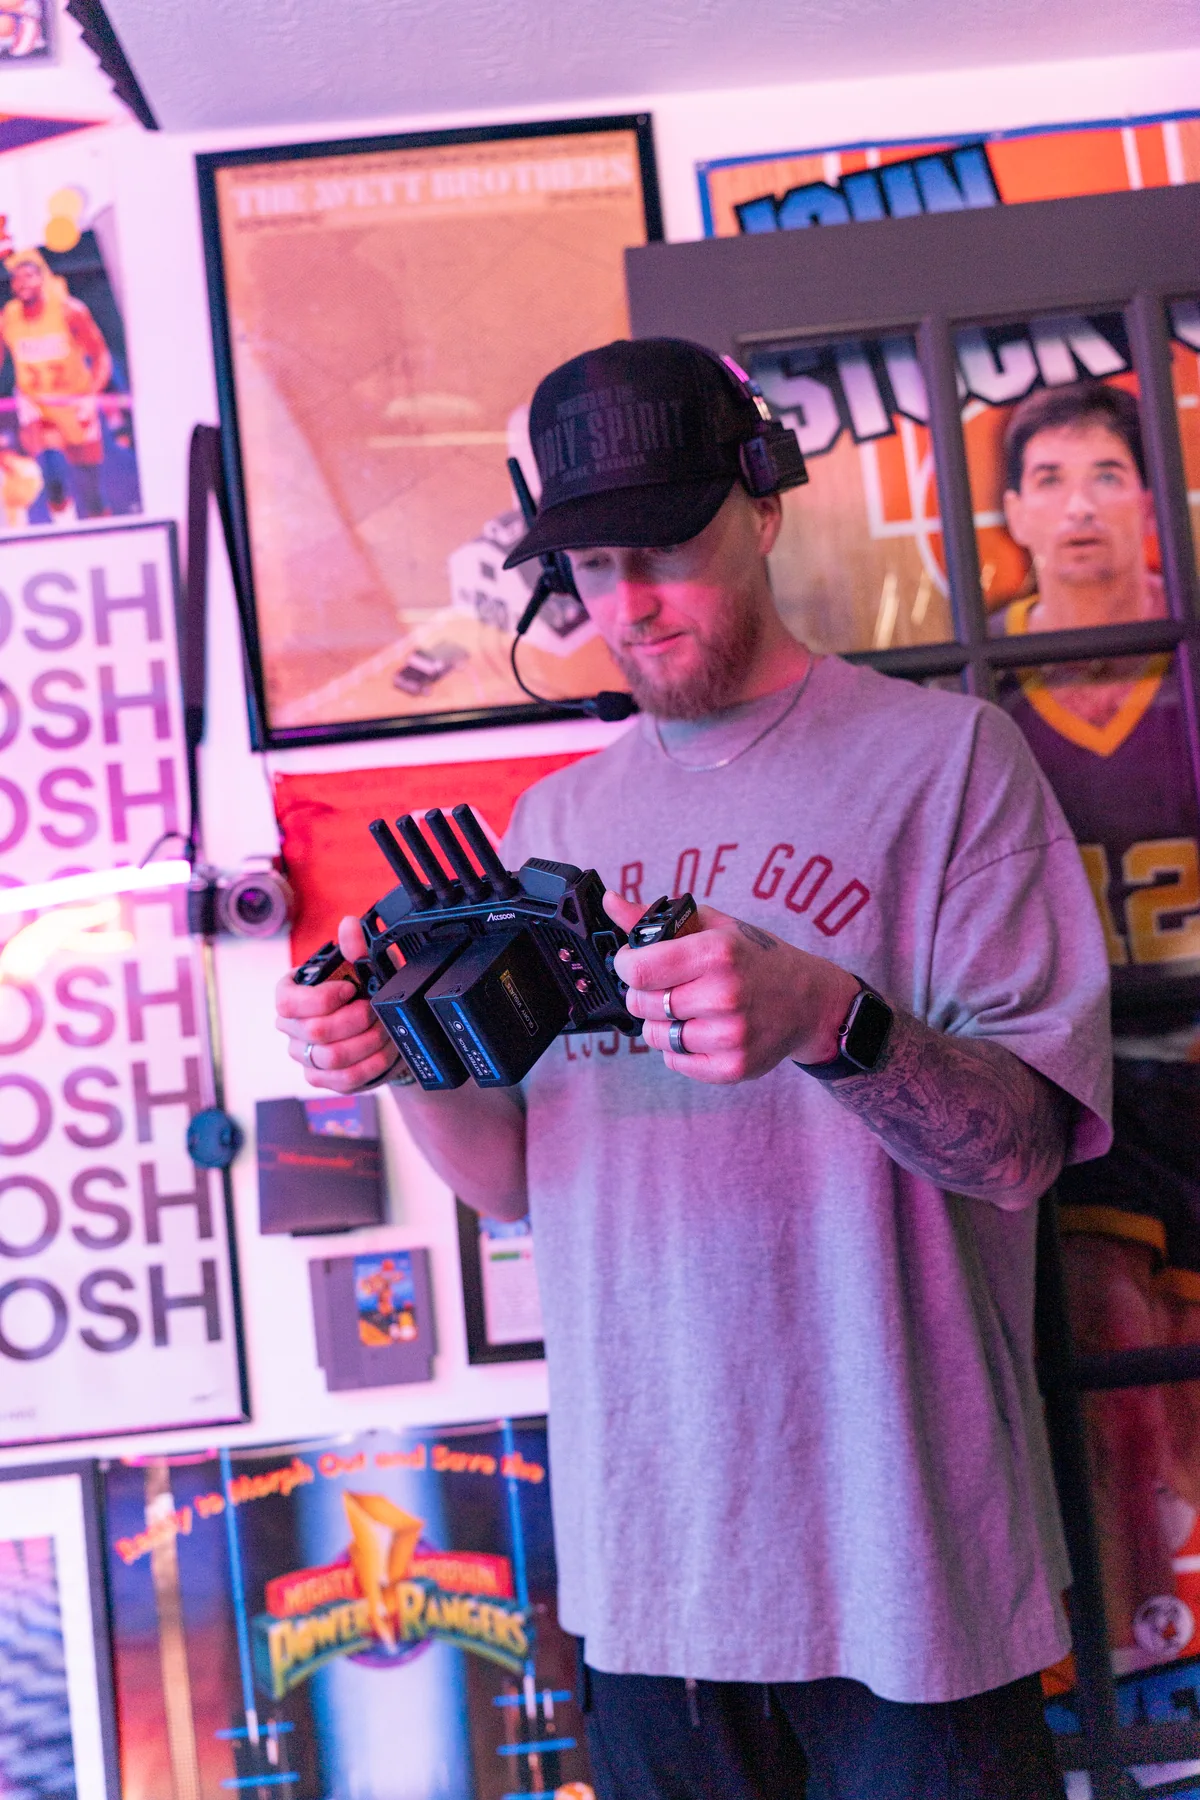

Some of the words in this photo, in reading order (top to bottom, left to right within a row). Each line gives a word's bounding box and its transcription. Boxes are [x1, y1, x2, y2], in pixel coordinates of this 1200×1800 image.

[0, 562, 163, 652] SH
[0, 659, 172, 753] SH
[672, 843, 740, 900] OF
[752, 842, 872, 938] GOD
[457, 1037, 470, 1053] PACK
[466, 1053, 484, 1077] BATTERY
